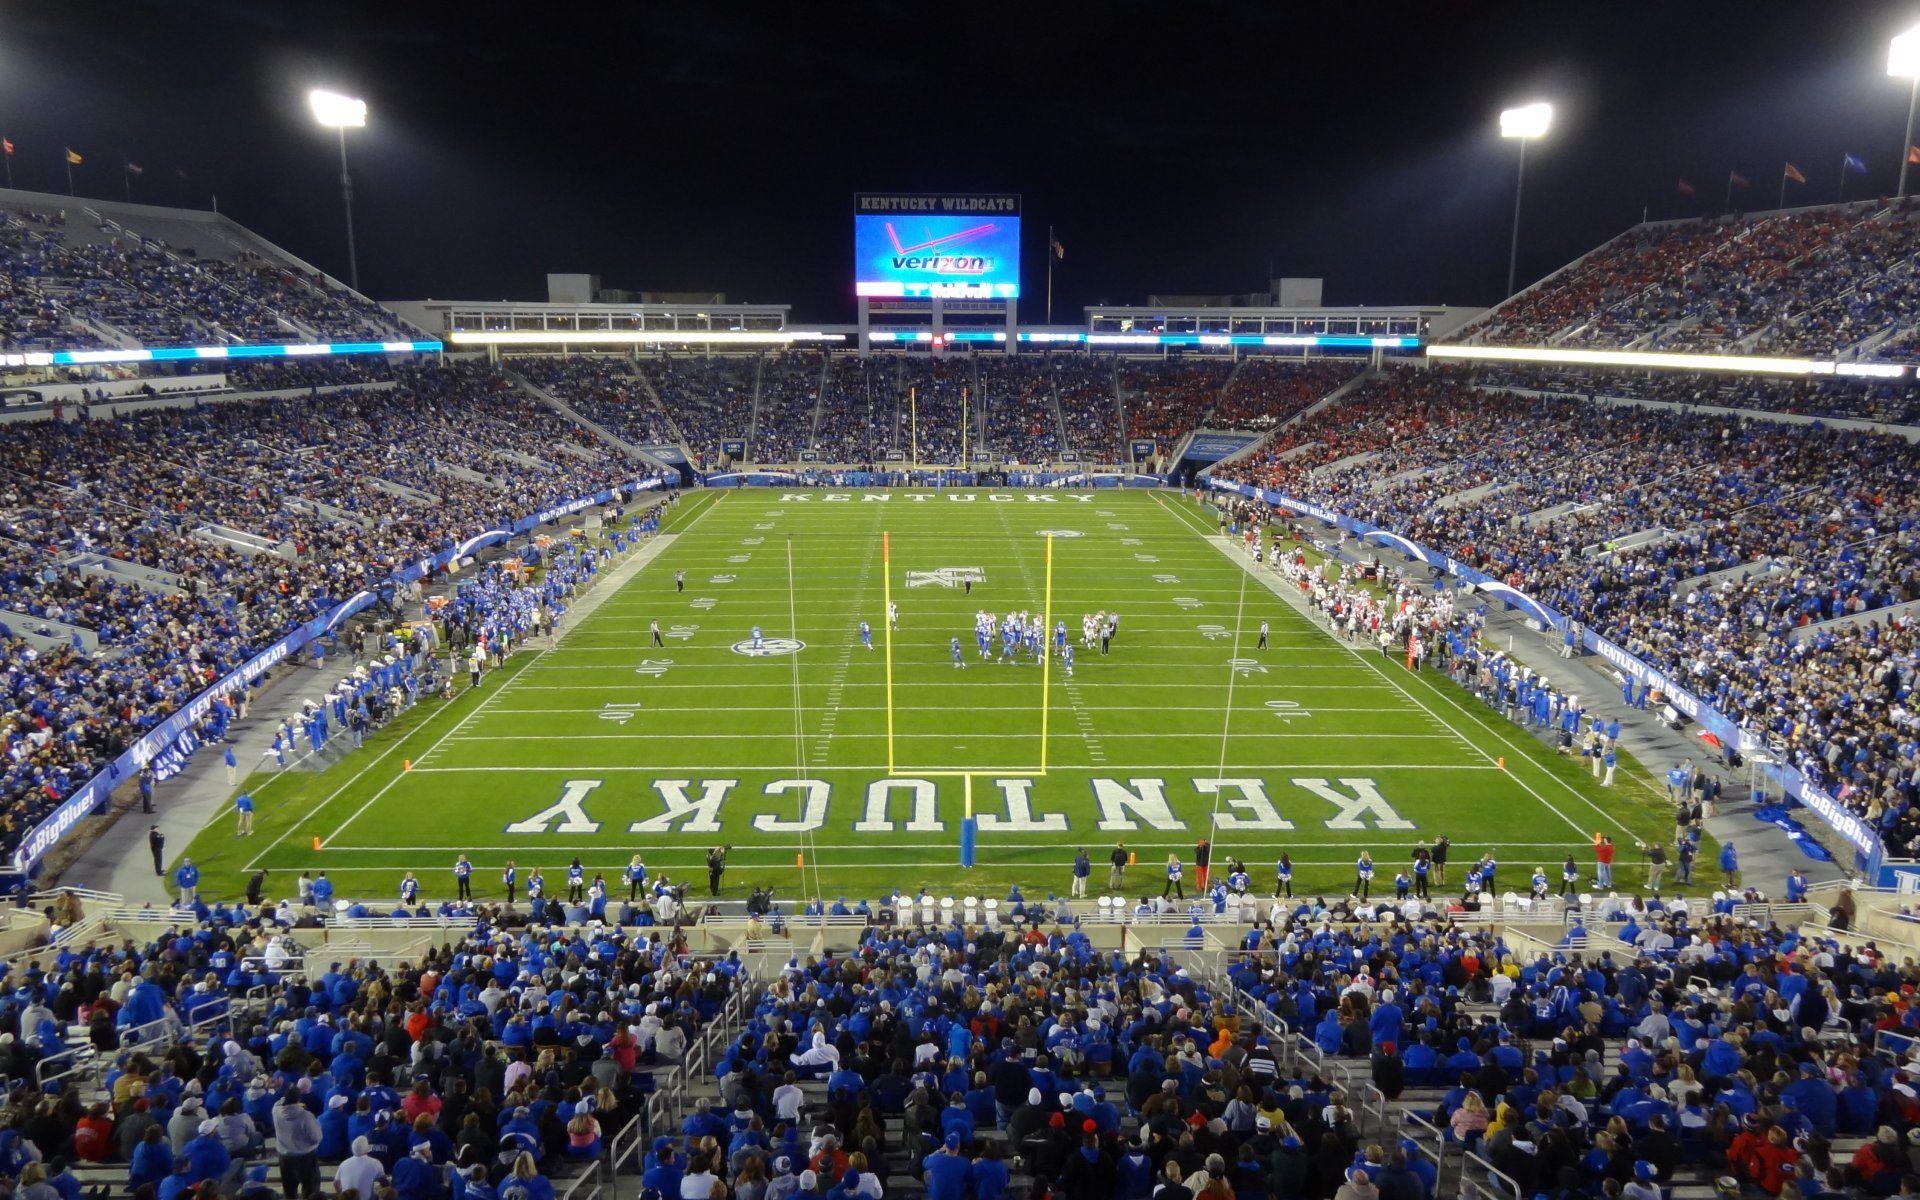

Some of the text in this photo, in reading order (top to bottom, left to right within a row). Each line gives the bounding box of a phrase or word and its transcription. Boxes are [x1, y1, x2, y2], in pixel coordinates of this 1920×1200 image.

[861, 197, 1014, 210] KENTUCKY WILDCATS
[892, 253, 985, 272] verizon
[779, 494, 1095, 503] KENTUCKY
[1280, 497, 1309, 513] KENTUCKY
[244, 642, 287, 680] WILDCATS
[1596, 639, 1645, 679] KENTUCKY
[598, 702, 641, 720] 10
[1265, 700, 1312, 717] 10
[506, 778, 1417, 833] KENTUCKY
